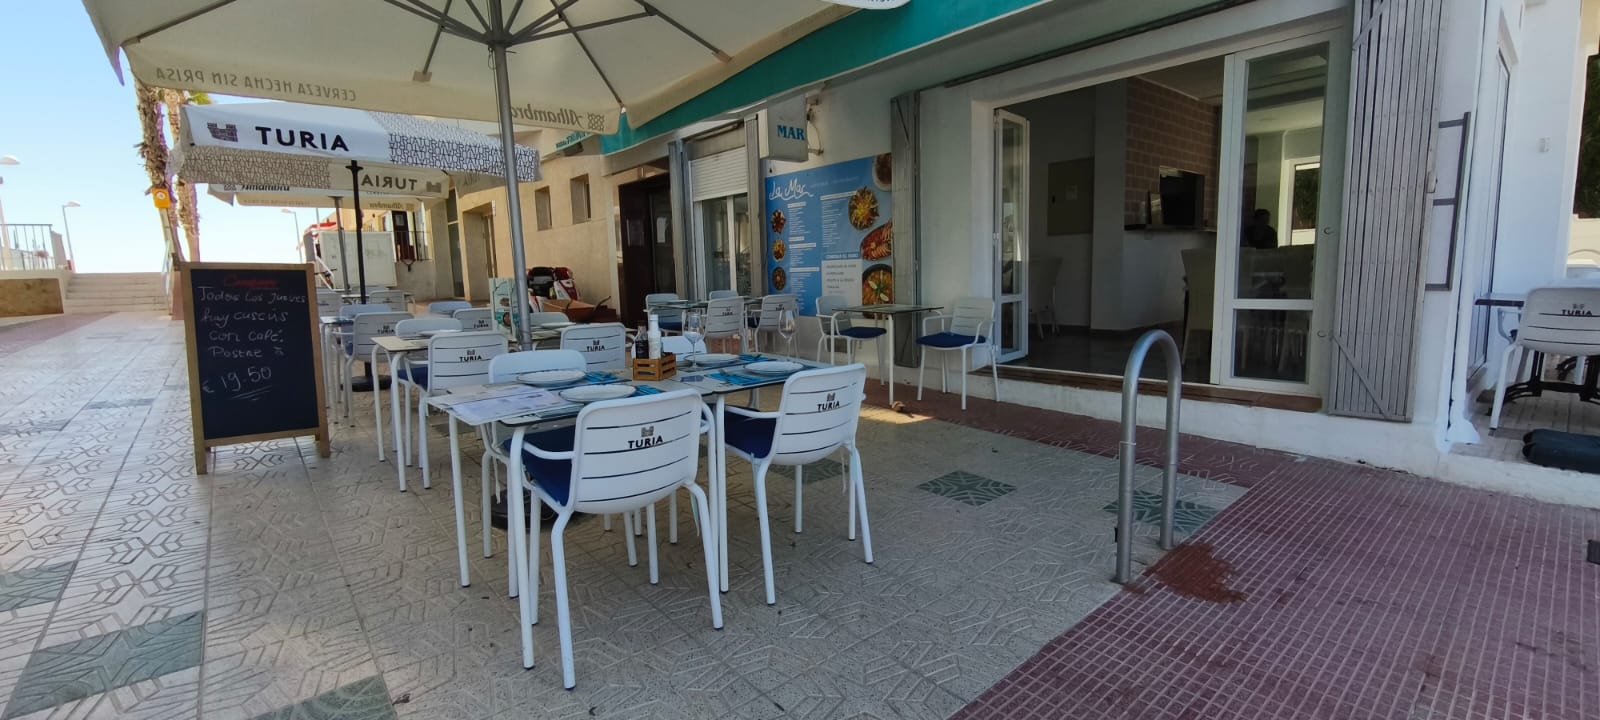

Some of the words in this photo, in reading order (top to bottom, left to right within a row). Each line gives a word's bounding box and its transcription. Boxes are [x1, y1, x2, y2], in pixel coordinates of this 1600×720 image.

[255, 126, 349, 152] TURIA
[777, 124, 805, 141] MAR
[201, 308, 230, 328] hay
[1561, 309, 1593, 317] TURIA
[459, 355, 482, 364] TURIA
[221, 366, 272, 392] 19.50
[817, 401, 840, 412] TURIA
[628, 435, 664, 449] TURIA
